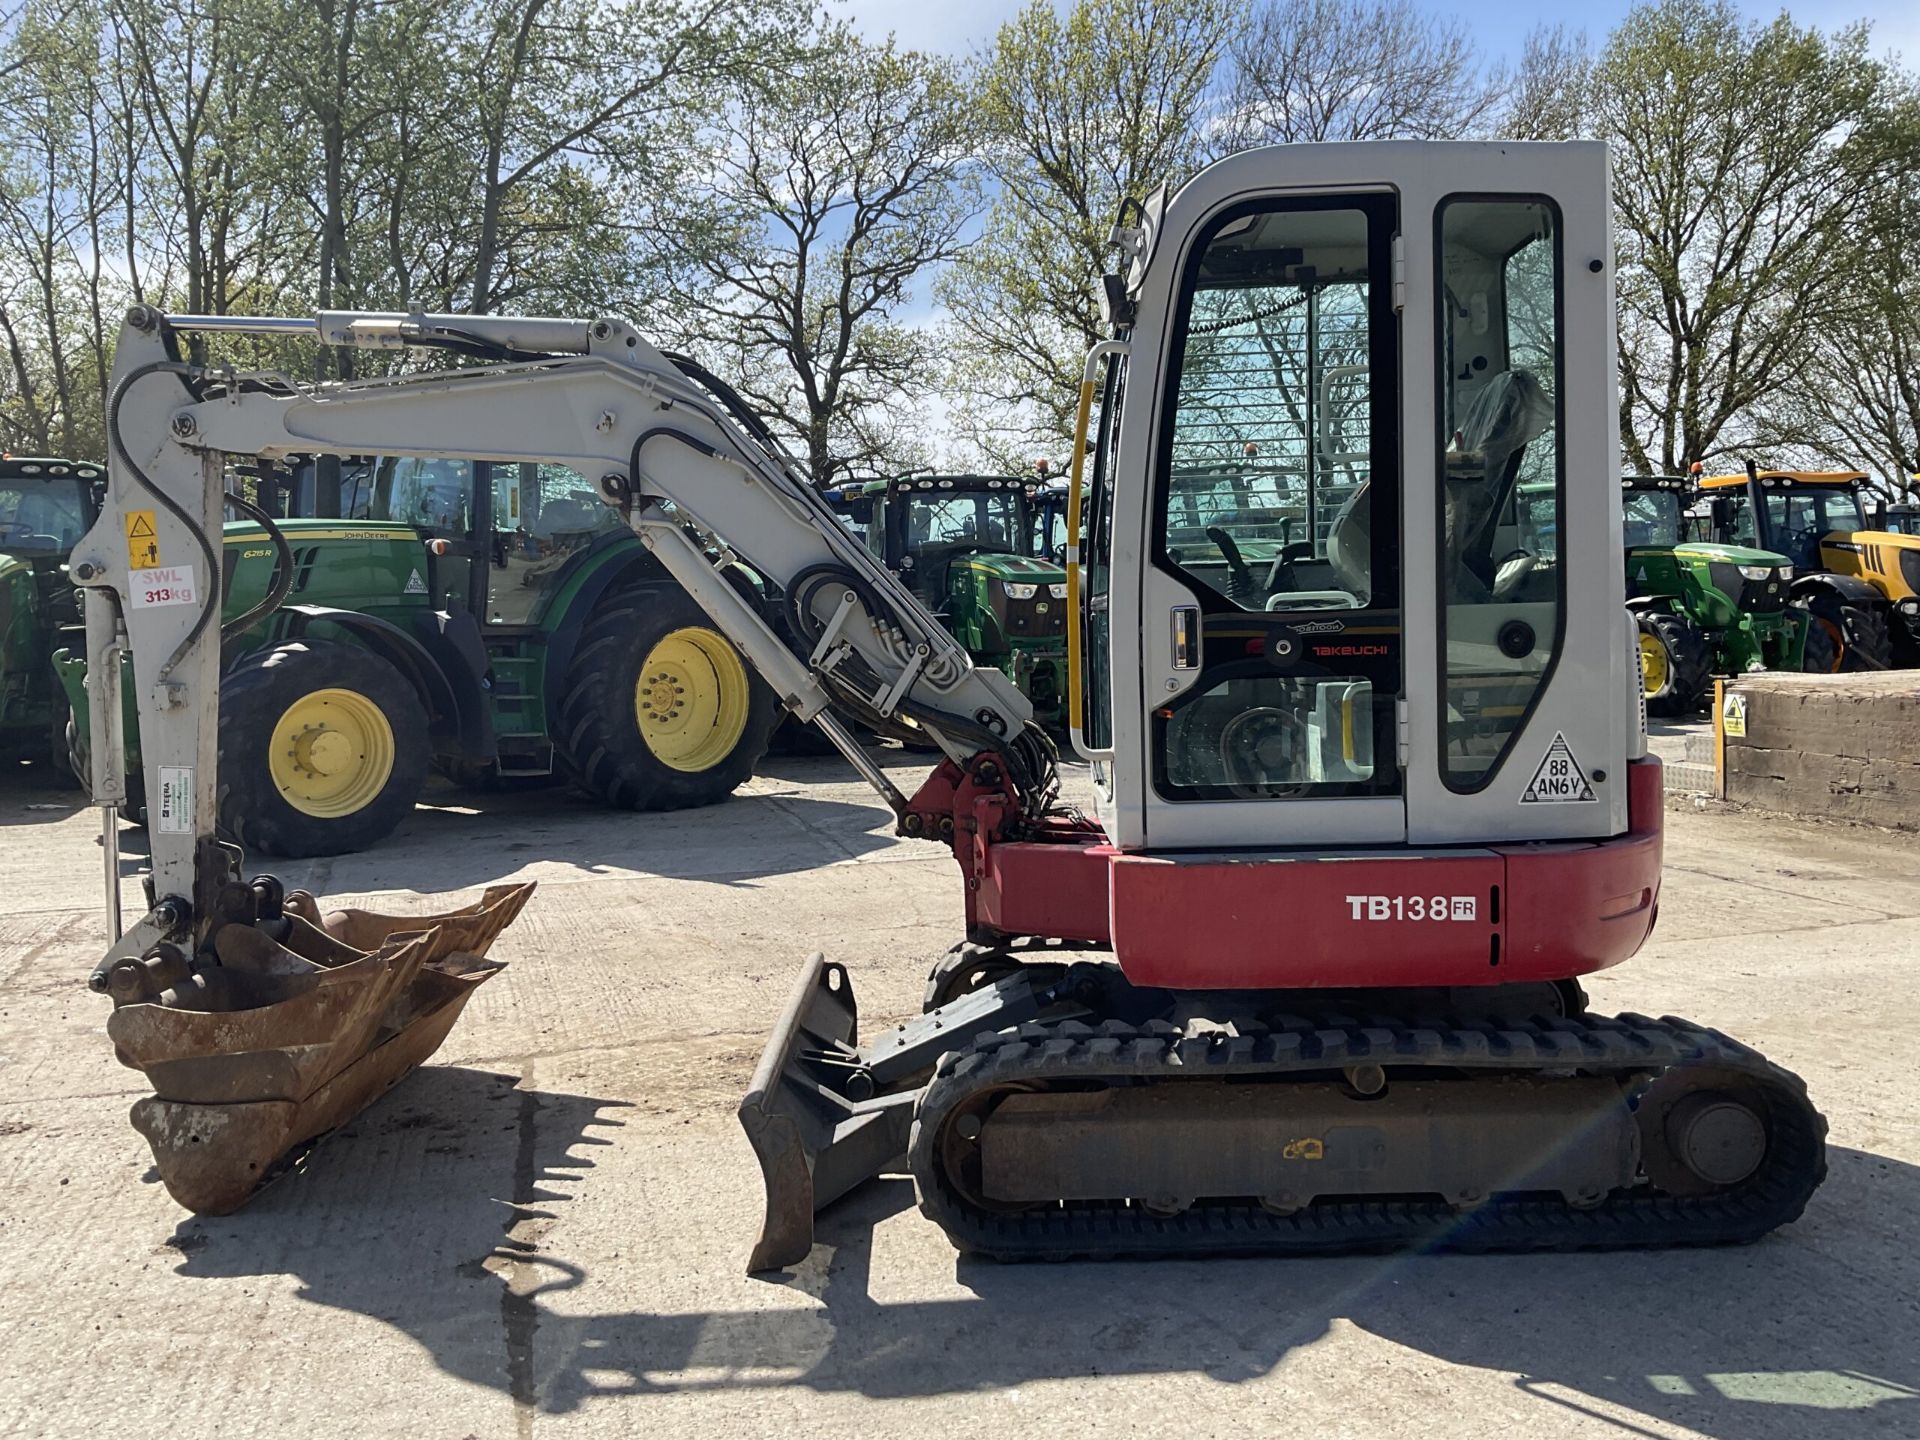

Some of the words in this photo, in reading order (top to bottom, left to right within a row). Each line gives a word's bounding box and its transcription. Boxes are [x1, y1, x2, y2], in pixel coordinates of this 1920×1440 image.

[344, 531, 363, 539] JOHN
[364, 531, 389, 539] DEERE
[143, 569, 182, 584] SWL
[1550, 760, 1569, 776] 88
[1538, 777, 1580, 795] AN6Y
[1345, 895, 1448, 921] TB138
[1452, 900, 1474, 917] FR
